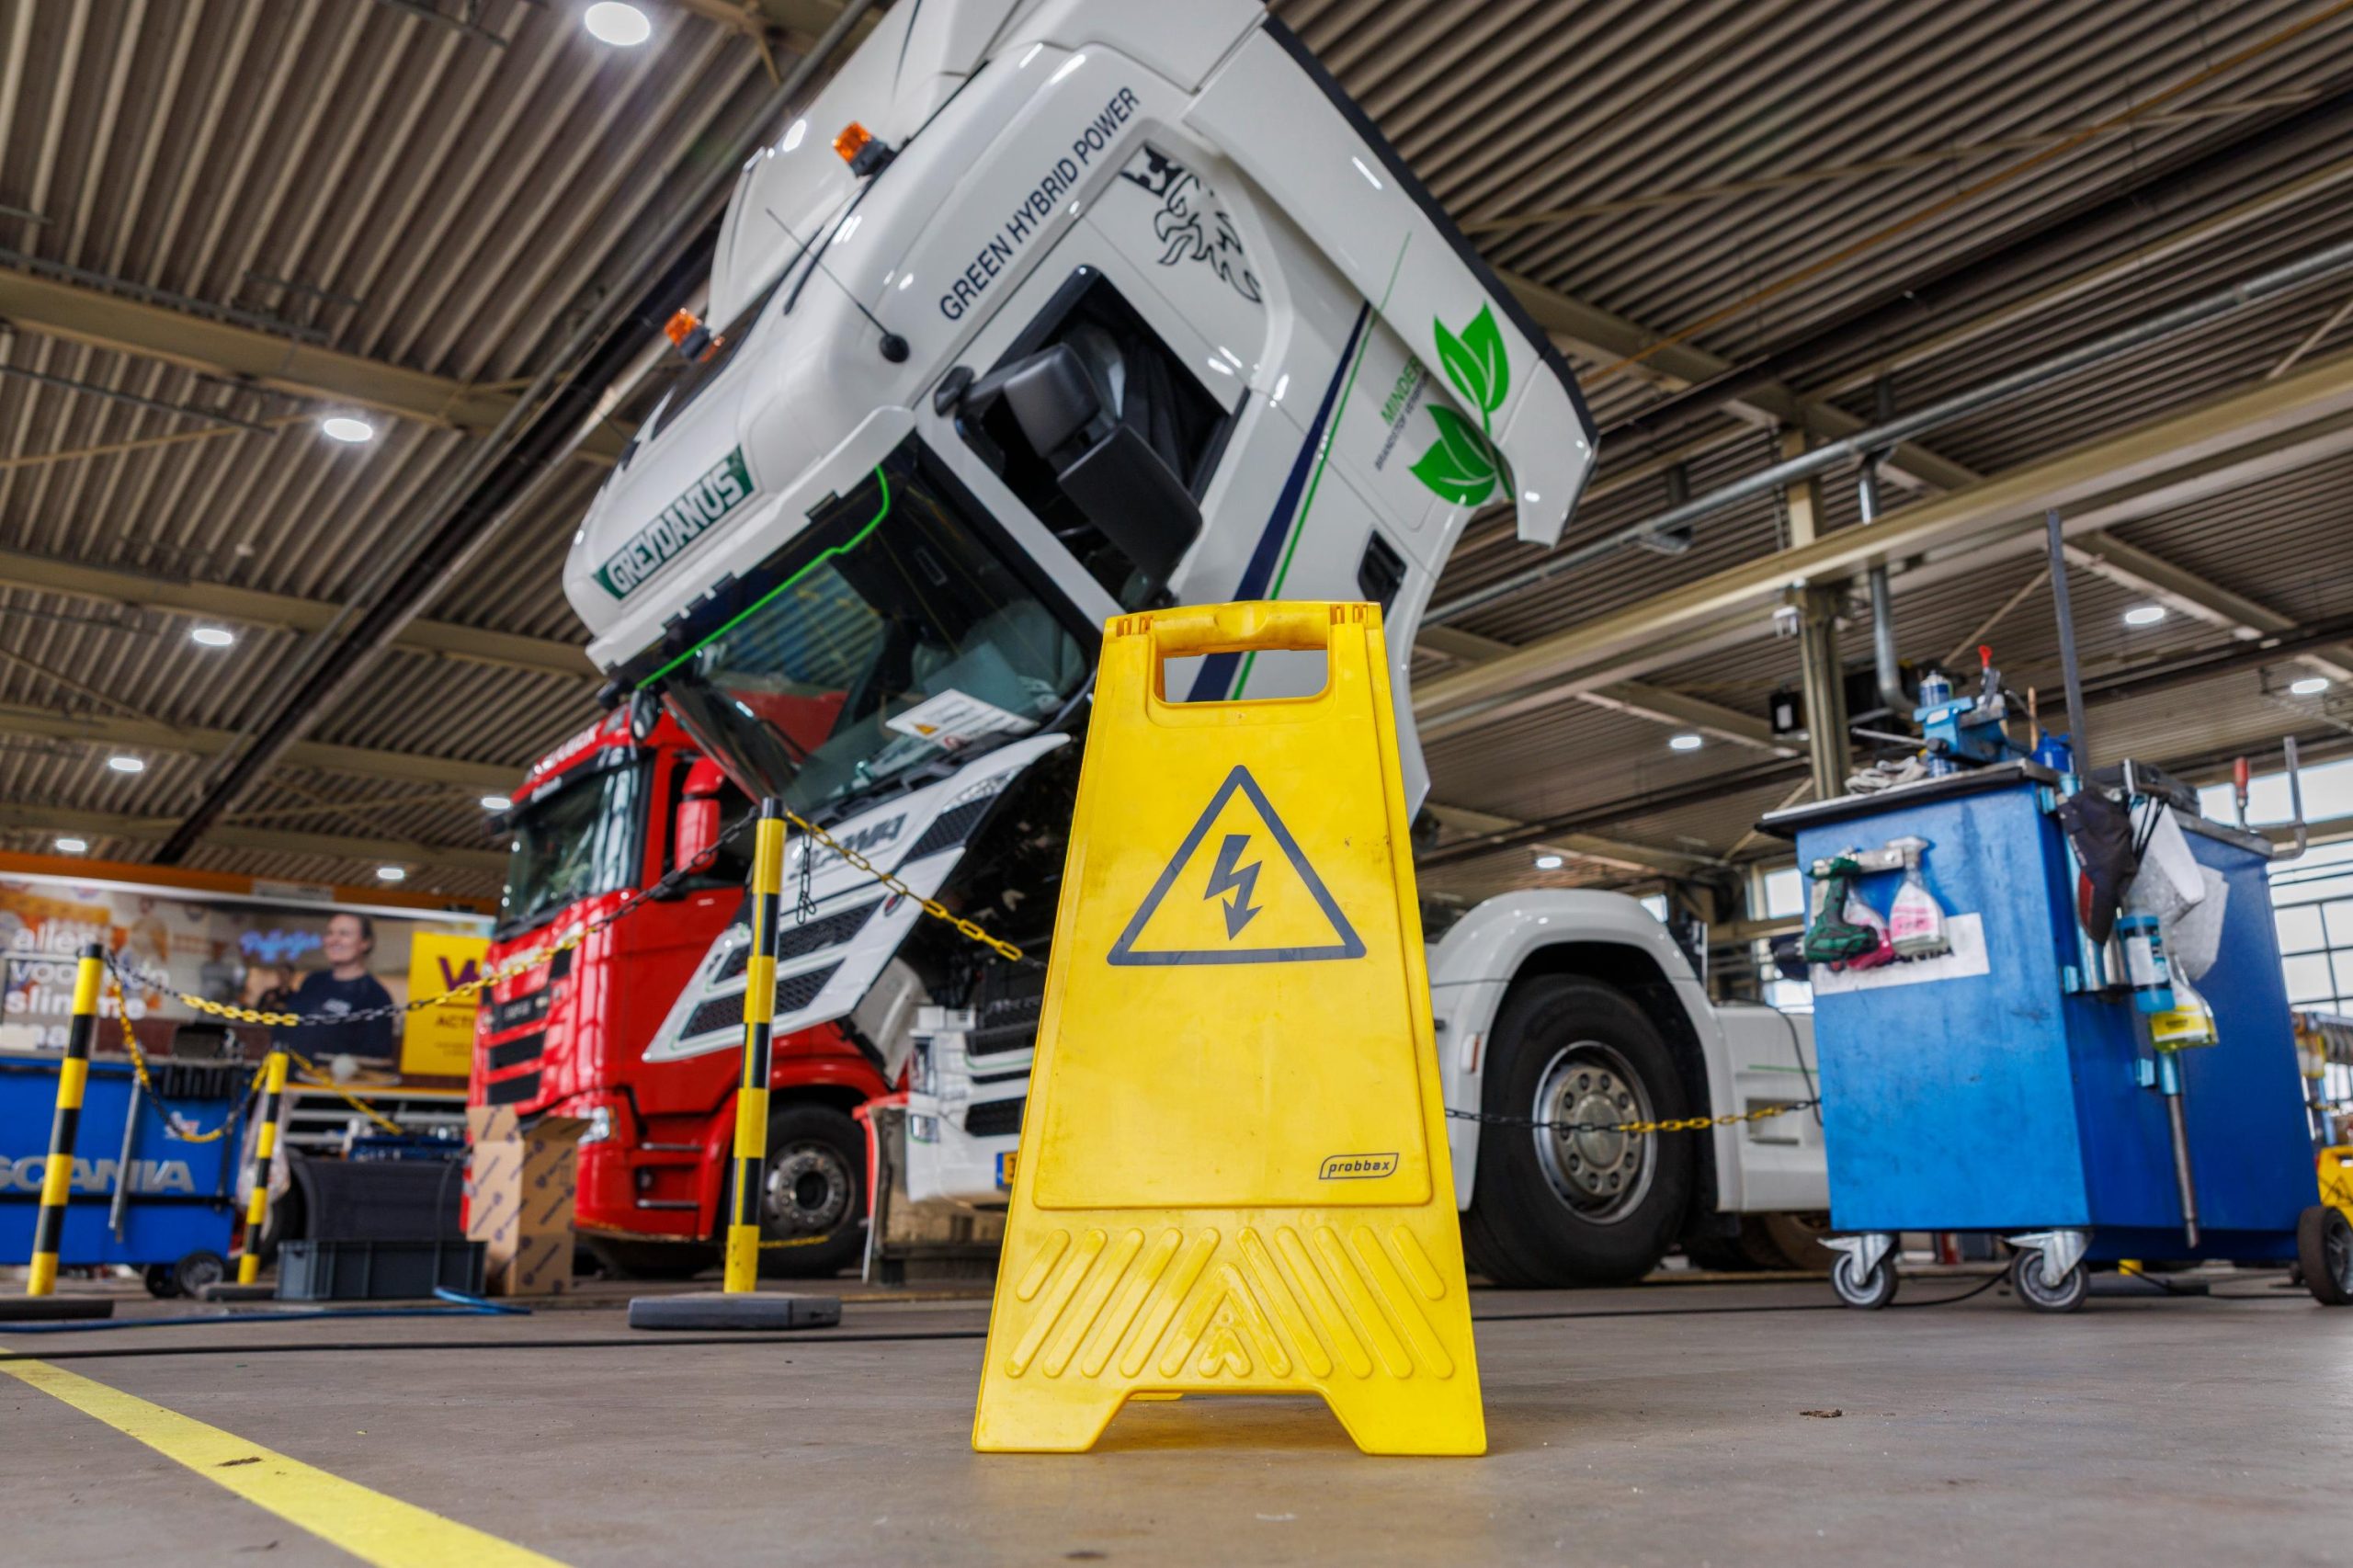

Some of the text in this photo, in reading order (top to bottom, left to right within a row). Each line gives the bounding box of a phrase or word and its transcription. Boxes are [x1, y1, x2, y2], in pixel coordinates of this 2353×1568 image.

[939, 86, 1141, 322] GREEN HYBRID POWER
[606, 461, 745, 595] GREYDANUS
[1328, 1160, 1390, 1178] probbax
